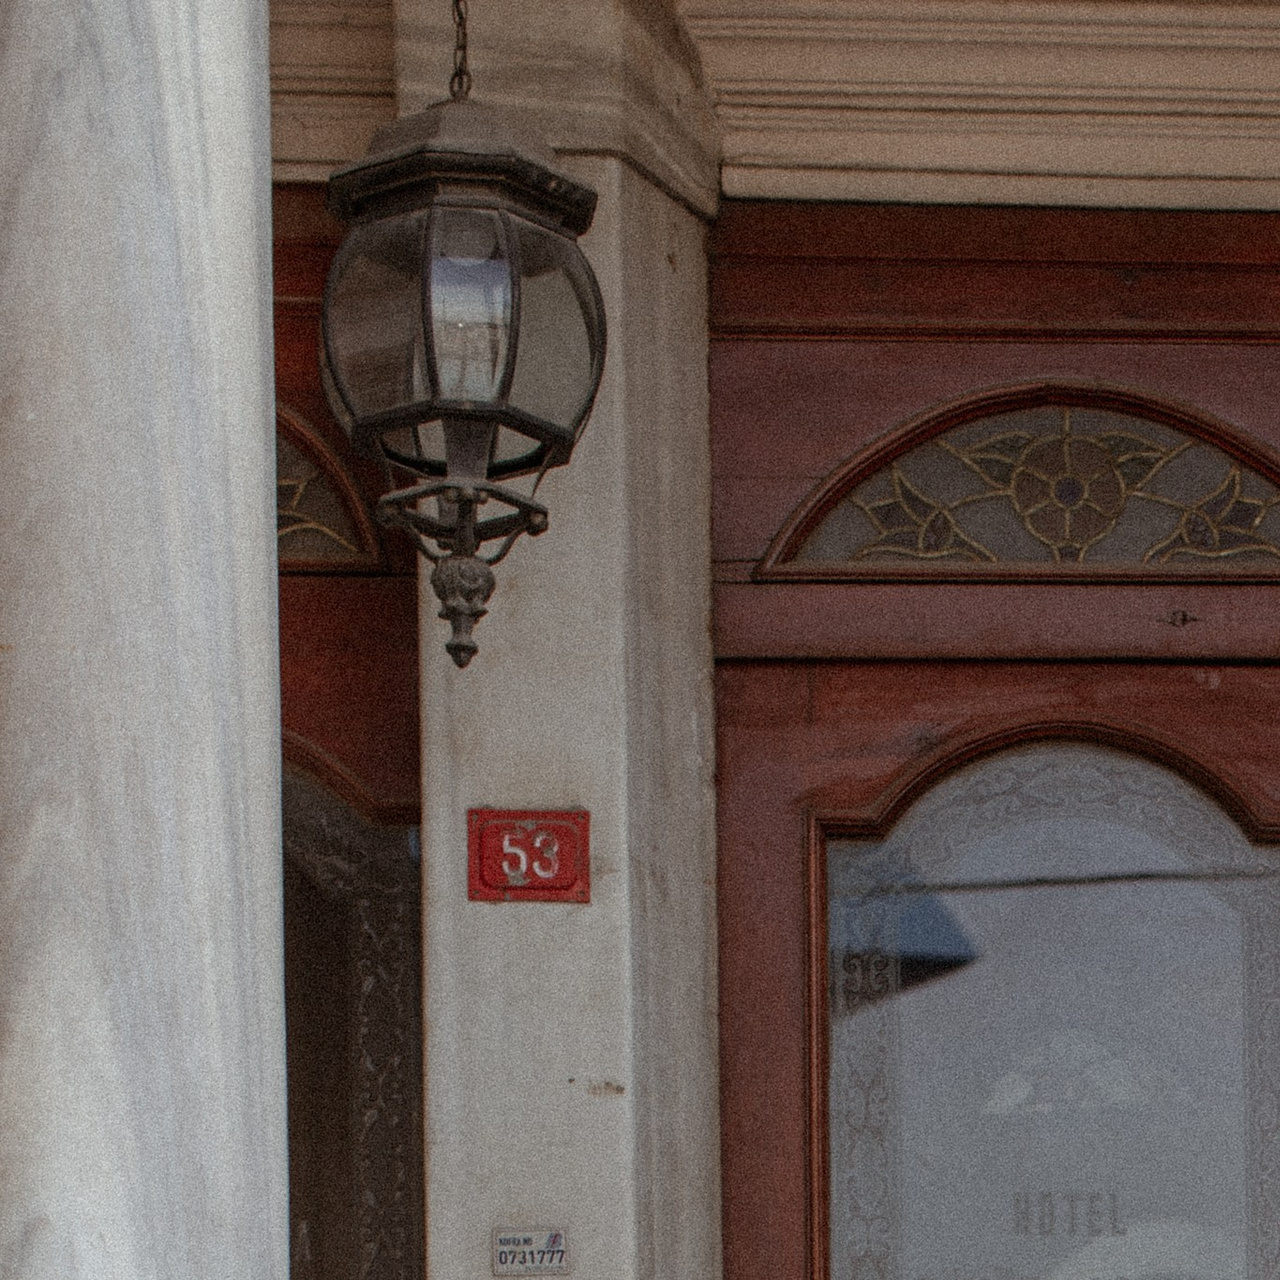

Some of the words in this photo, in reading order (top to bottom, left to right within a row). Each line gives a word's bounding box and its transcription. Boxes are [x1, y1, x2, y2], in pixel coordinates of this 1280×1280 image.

[501, 832, 560, 879] 53
[1013, 1190, 1128, 1237] HOTEL
[498, 1249, 566, 1265] 0731777
